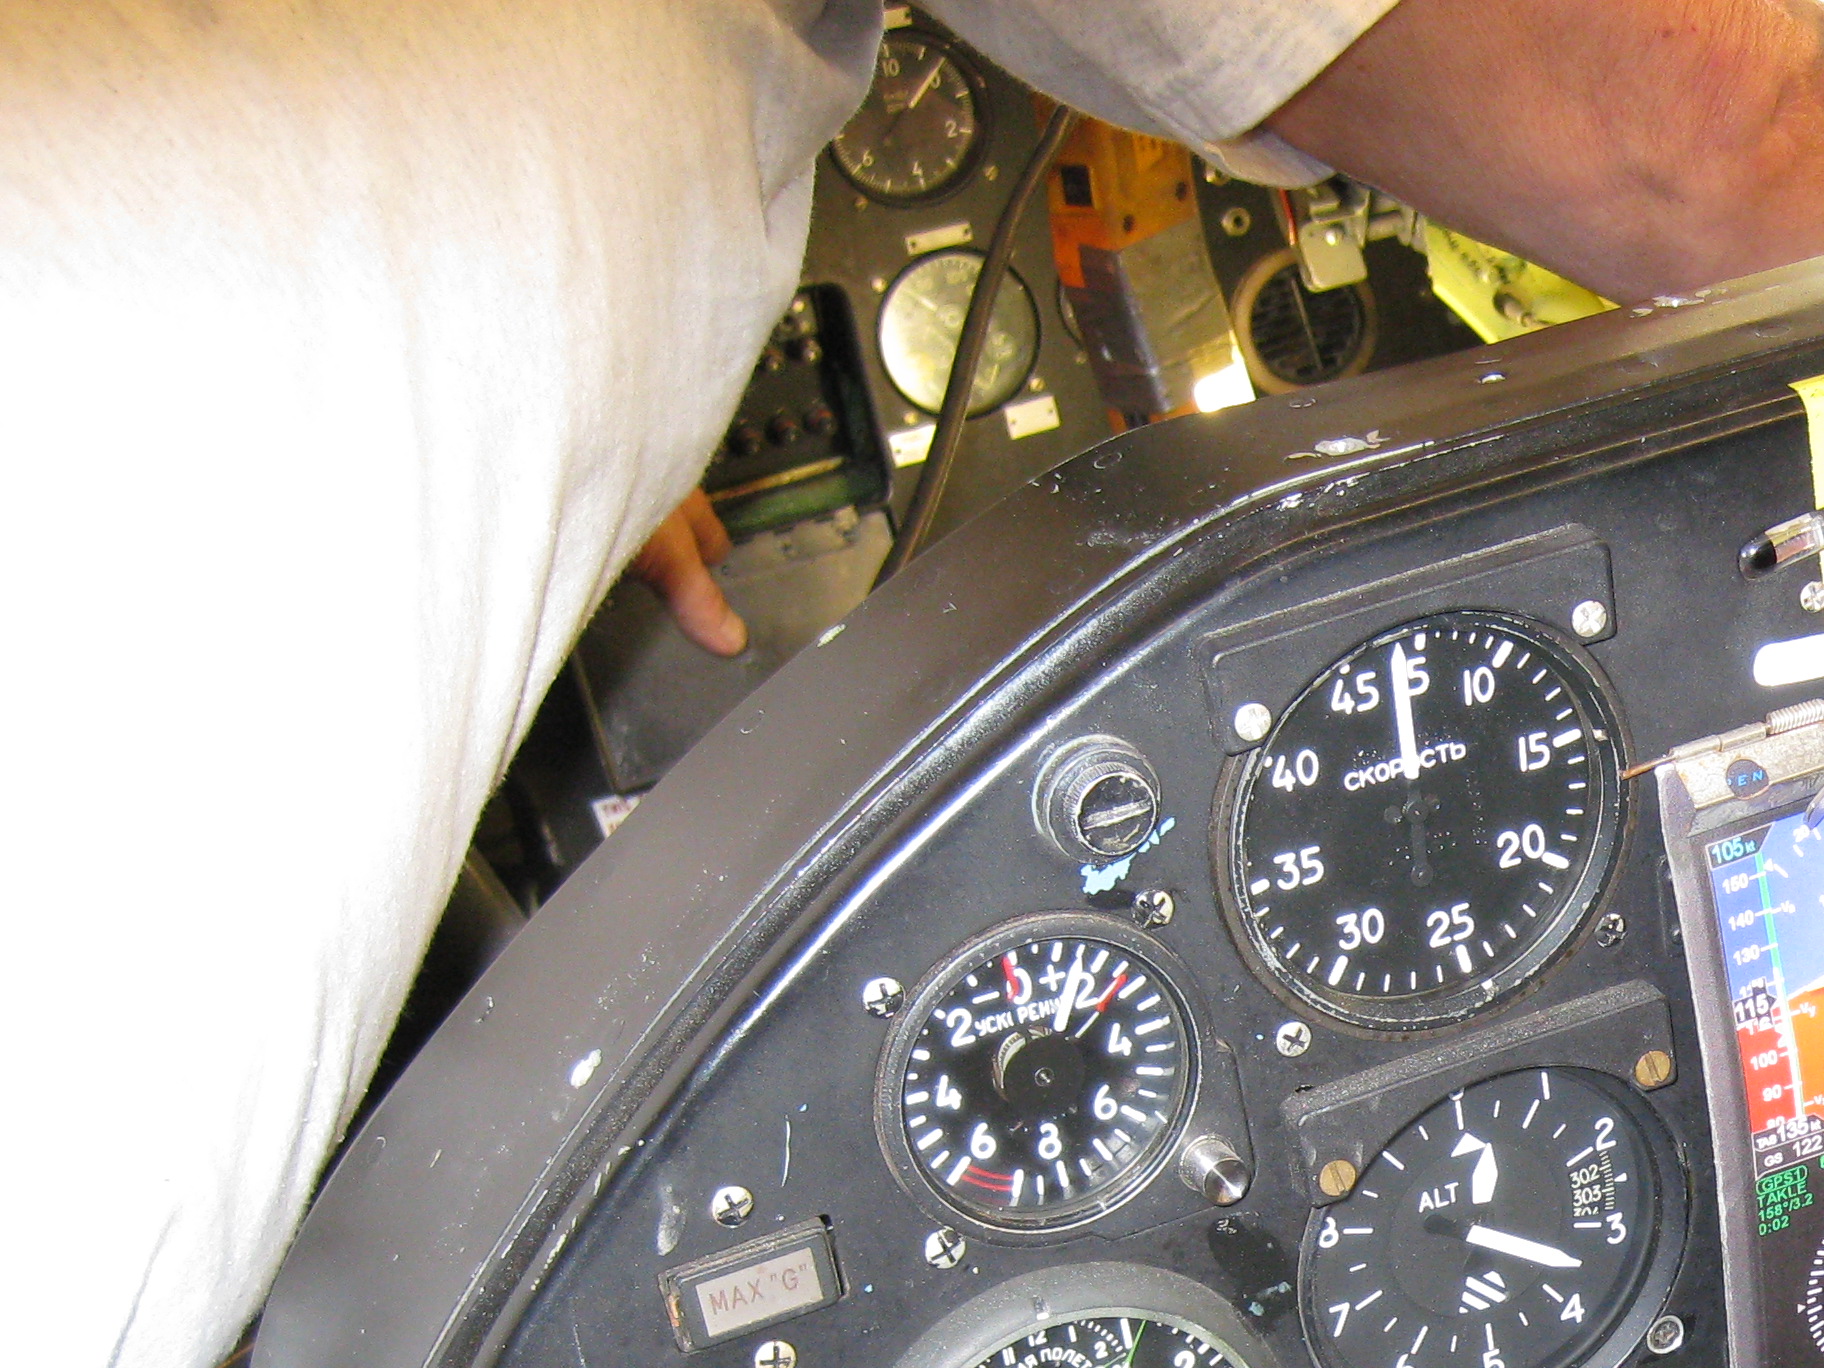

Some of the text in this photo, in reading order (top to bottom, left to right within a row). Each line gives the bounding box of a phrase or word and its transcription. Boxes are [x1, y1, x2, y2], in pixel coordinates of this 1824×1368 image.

[946, 121, 958, 138] 2
[1331, 671, 1379, 714] 45
[1463, 666, 1495, 706] 10
[1344, 743, 1466, 791] СКОРСТЬ
[1518, 731, 1552, 771] 15
[1272, 750, 1319, 792] 40
[1497, 825, 1545, 868] 20
[1712, 836, 1743, 863] 105
[1274, 847, 1324, 889] 35
[1722, 873, 1748, 894] 150
[1336, 909, 1384, 950] 30
[1427, 903, 1474, 948] 25
[1728, 910, 1754, 931] 140
[1733, 944, 1760, 965] 130
[1734, 994, 1769, 1022] 115
[947, 1008, 976, 1046] 2
[1109, 1023, 1133, 1055] 4
[1751, 1050, 1777, 1070] 100
[936, 1075, 962, 1110] 4
[1093, 1085, 1119, 1120] 6
[1762, 1084, 1782, 1101] 90
[970, 1123, 996, 1159] 6
[1038, 1123, 1062, 1159] 8
[1594, 1117, 1616, 1150] 2
[1777, 1119, 1809, 1142] 135
[1764, 1134, 1822, 1167] GS 122
[1570, 1164, 1600, 1189] 302
[1762, 1169, 1801, 1193] GPS1
[1418, 1182, 1459, 1213] ALT
[1758, 1181, 1807, 1208] TAKLE
[1319, 1217, 1338, 1249] 8
[1606, 1212, 1627, 1243] 3
[1759, 1215, 1789, 1236] 0:02
[709, 1278, 764, 1315] MAX
[1560, 1293, 1584, 1324] 4
[1328, 1303, 1350, 1337] 7
[1094, 1341, 1108, 1359] 2
